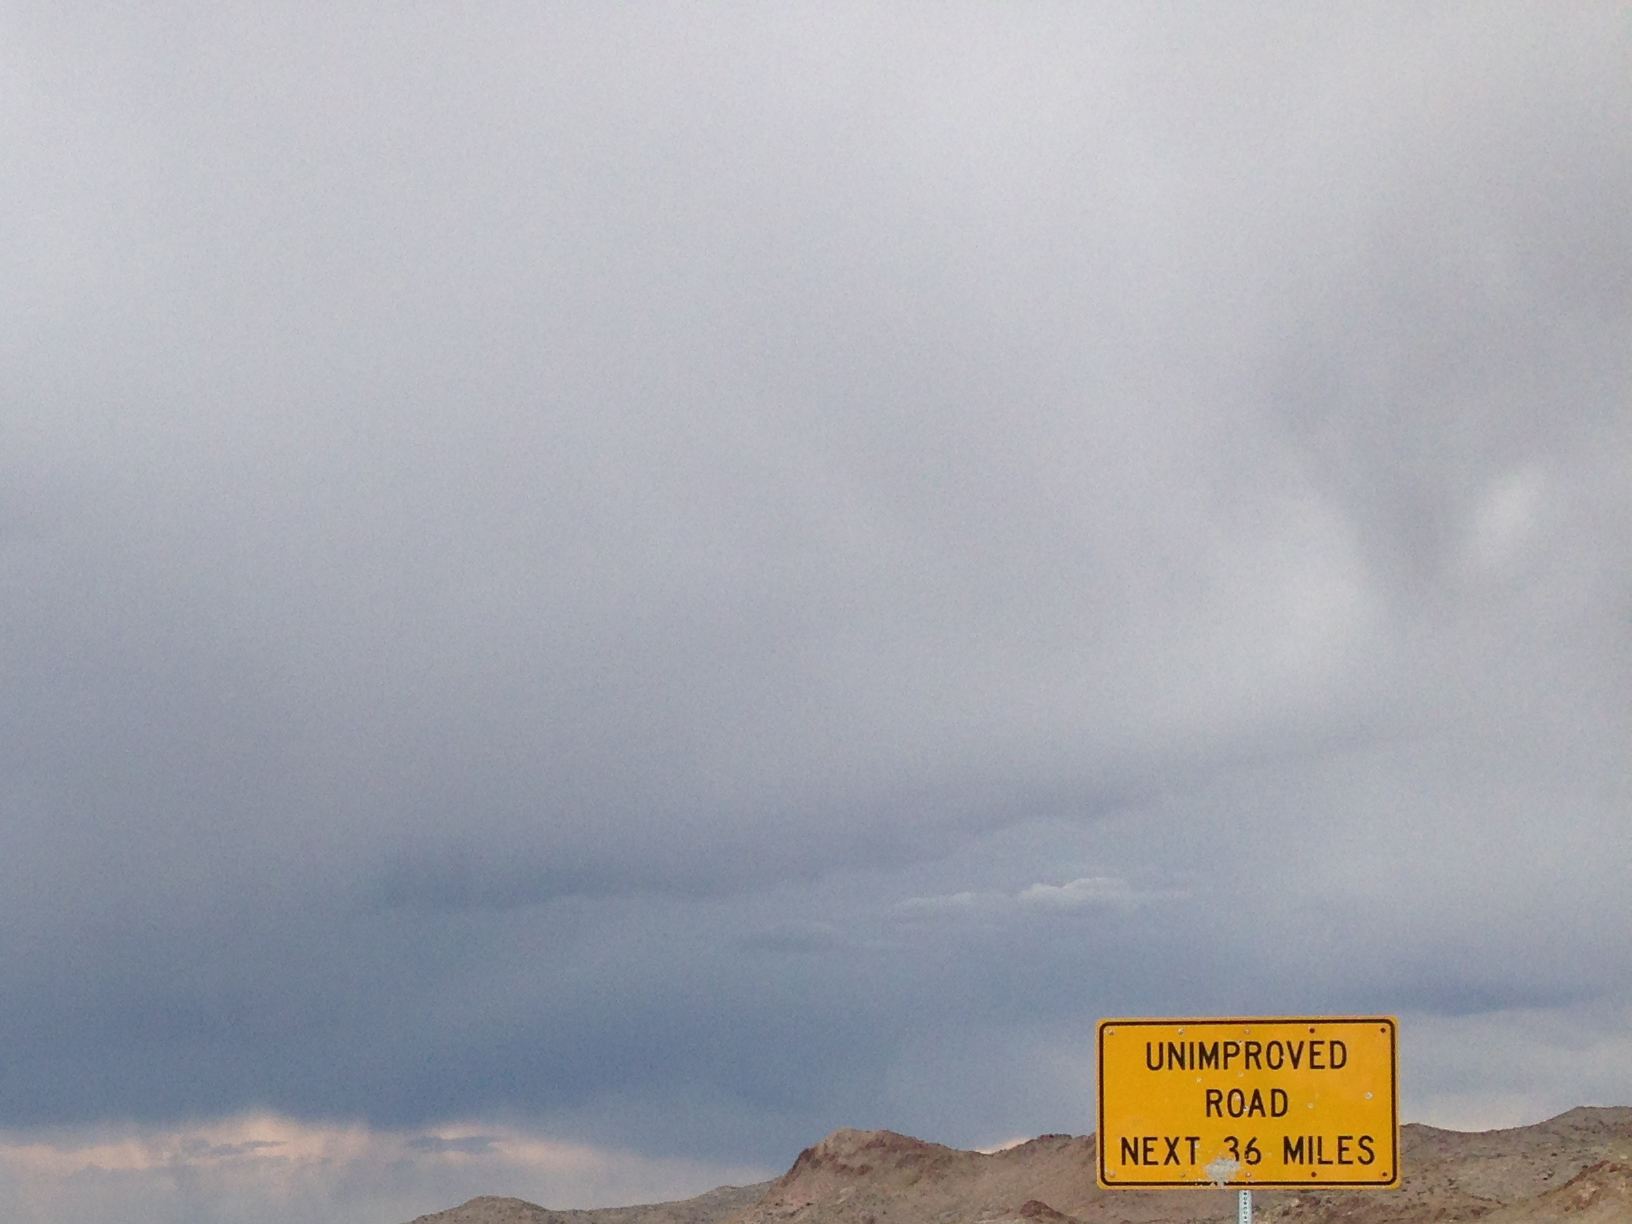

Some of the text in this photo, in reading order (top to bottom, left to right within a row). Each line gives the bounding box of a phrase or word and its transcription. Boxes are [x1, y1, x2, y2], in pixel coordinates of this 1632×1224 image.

[1145, 1040, 1348, 1071] UNIMPROVED
[1205, 1087, 1289, 1118] ROAD
[1121, 1134, 1375, 1166] NEXT 36 MILES
